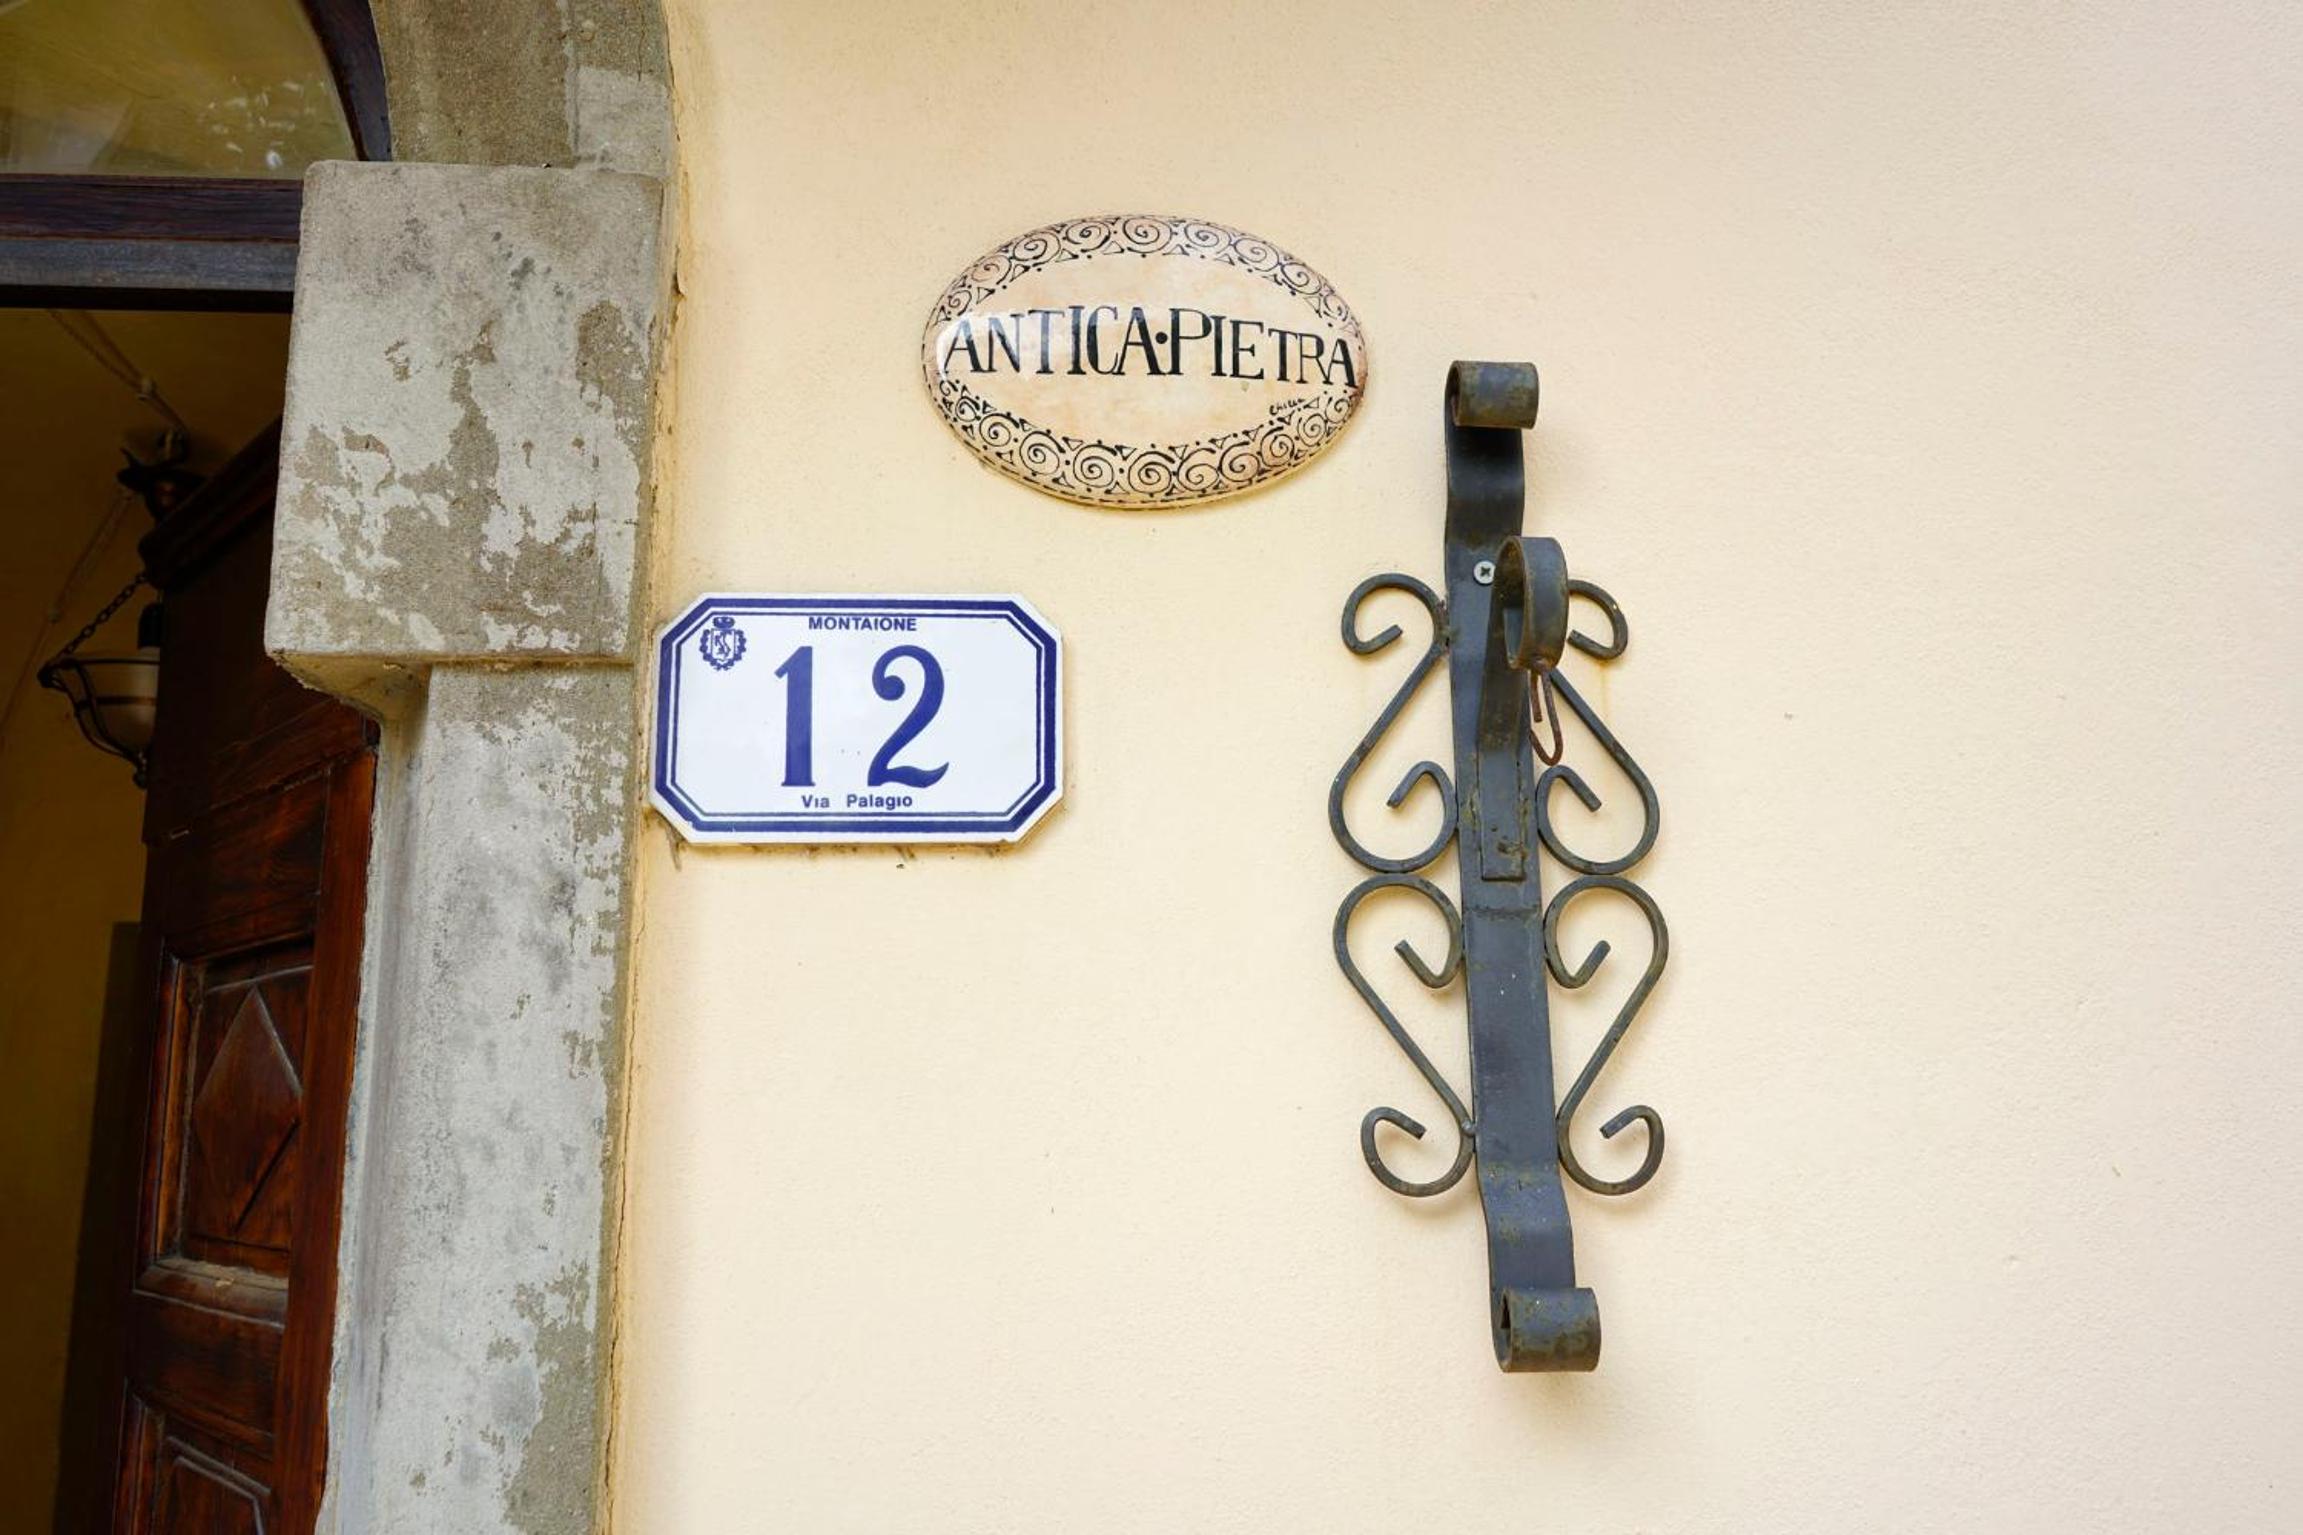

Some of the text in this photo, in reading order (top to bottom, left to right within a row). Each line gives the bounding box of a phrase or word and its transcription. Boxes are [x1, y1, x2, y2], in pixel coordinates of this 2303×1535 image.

[808, 616, 917, 631] MONTAIONE
[774, 644, 949, 788] 12
[801, 793, 913, 811] Via Palagio
